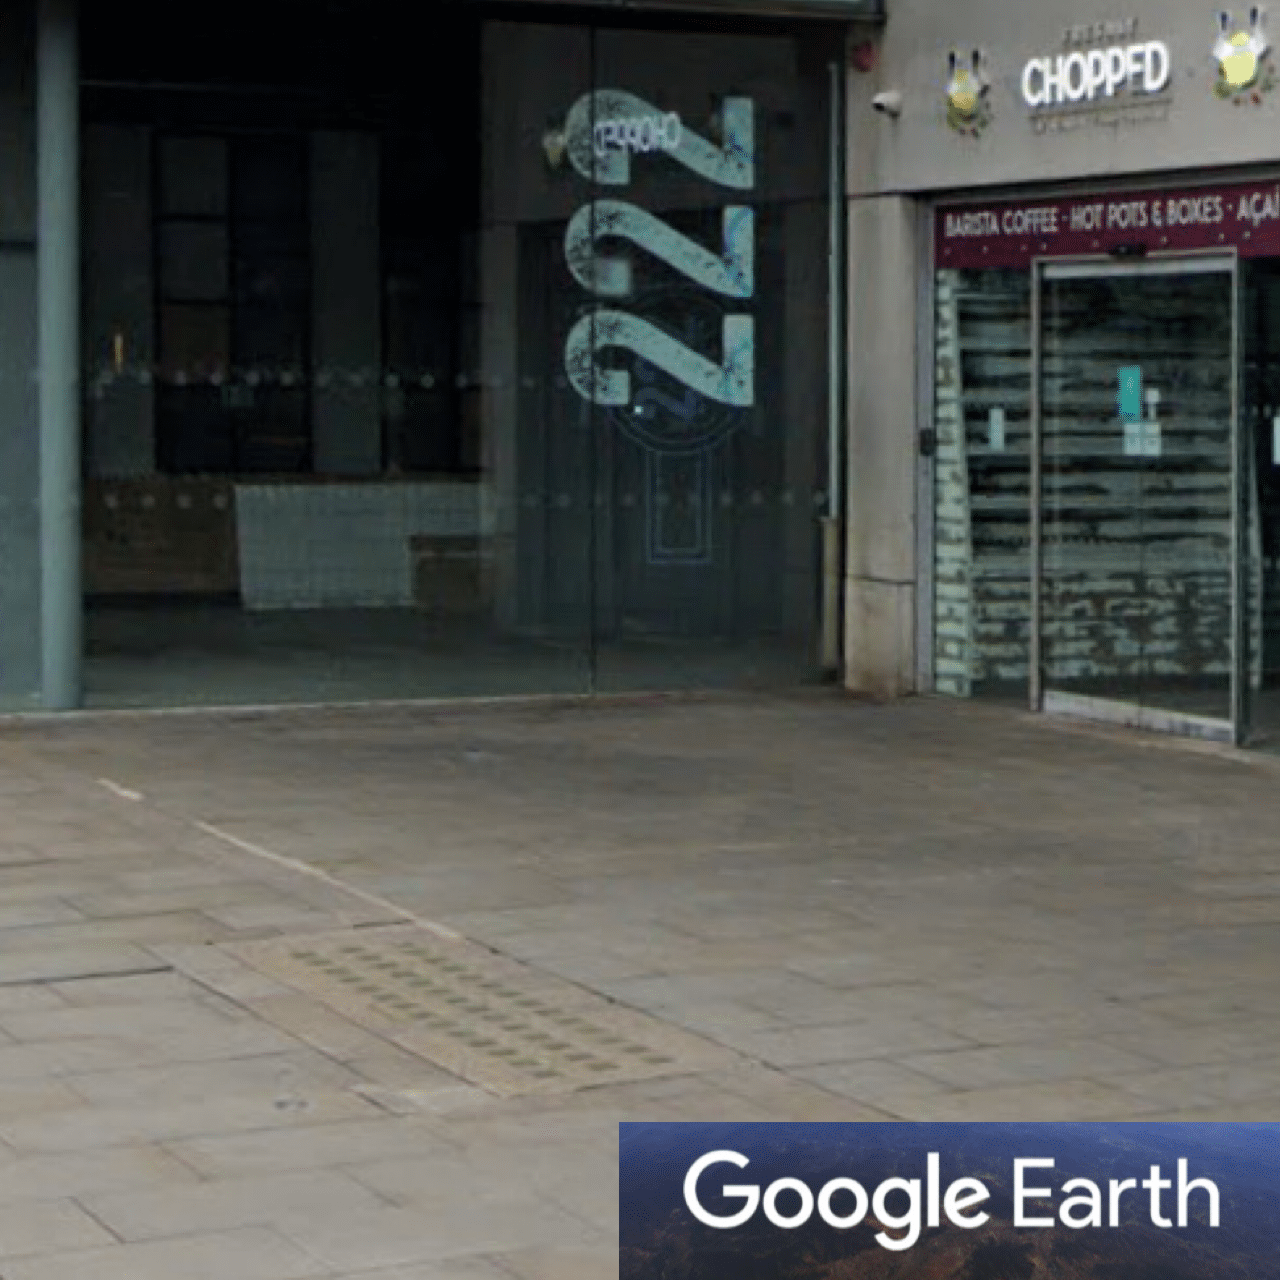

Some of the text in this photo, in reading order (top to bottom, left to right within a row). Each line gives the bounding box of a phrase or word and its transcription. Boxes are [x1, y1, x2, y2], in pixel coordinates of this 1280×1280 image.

[1022, 41, 1169, 107] CHOPPED
[1003, 207, 1059, 234] COFFEE
[1070, 204, 1104, 231] HOT
[1107, 200, 1148, 229] POTS
[1167, 195, 1224, 226] BOXES
